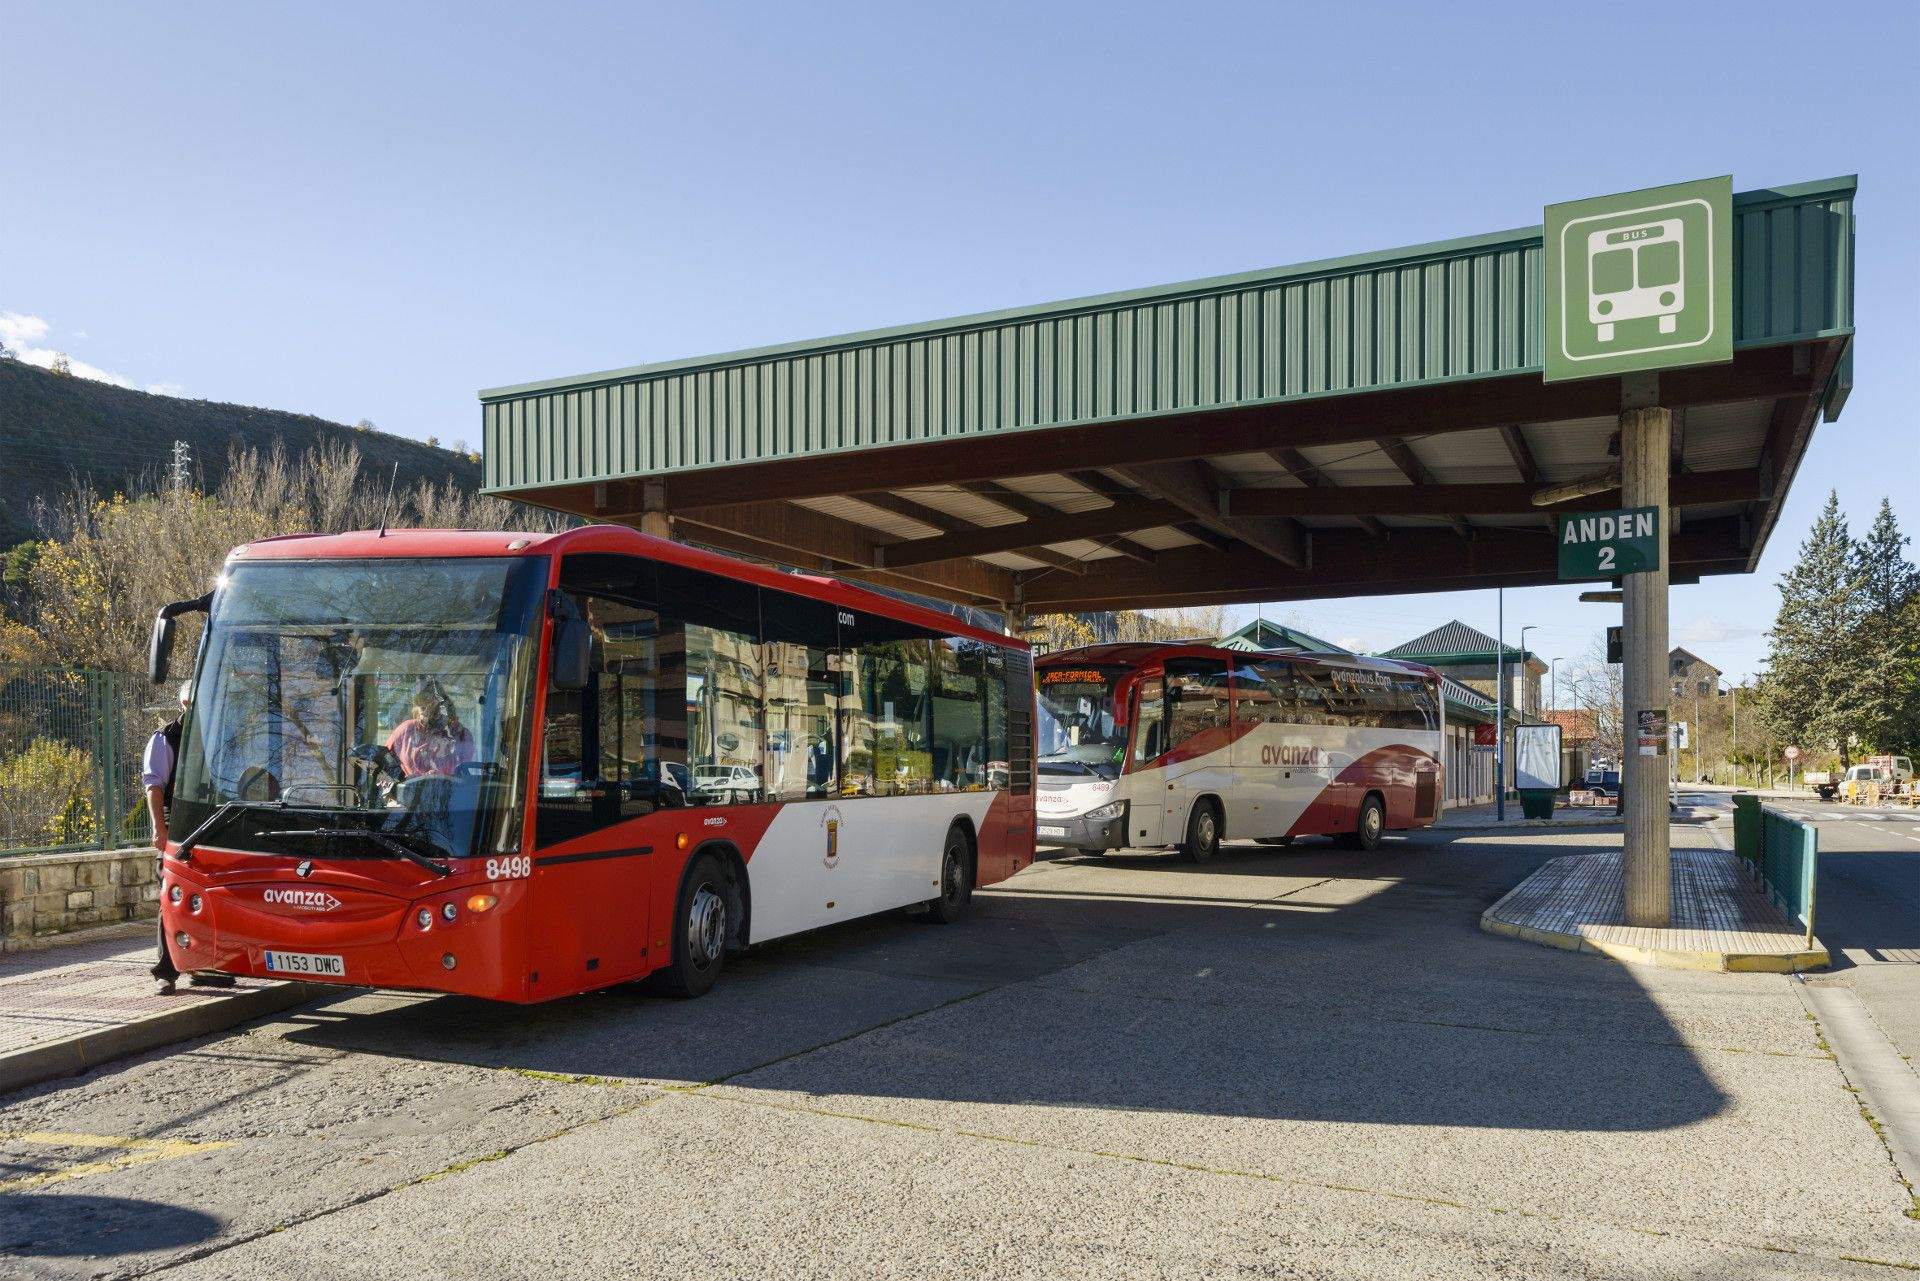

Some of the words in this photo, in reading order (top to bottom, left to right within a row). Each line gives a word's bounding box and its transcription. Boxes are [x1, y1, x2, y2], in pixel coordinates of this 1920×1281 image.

[1623, 230, 1647, 240] BUS
[1564, 513, 1652, 544] ANDEN
[1598, 547, 1615, 570] 2
[838, 612, 854, 626] com
[1261, 745, 1319, 765] avanza
[486, 856, 531, 880] 8498
[264, 889, 325, 906] avanza
[278, 955, 309, 971] 1153
[315, 957, 341, 973] DWC
